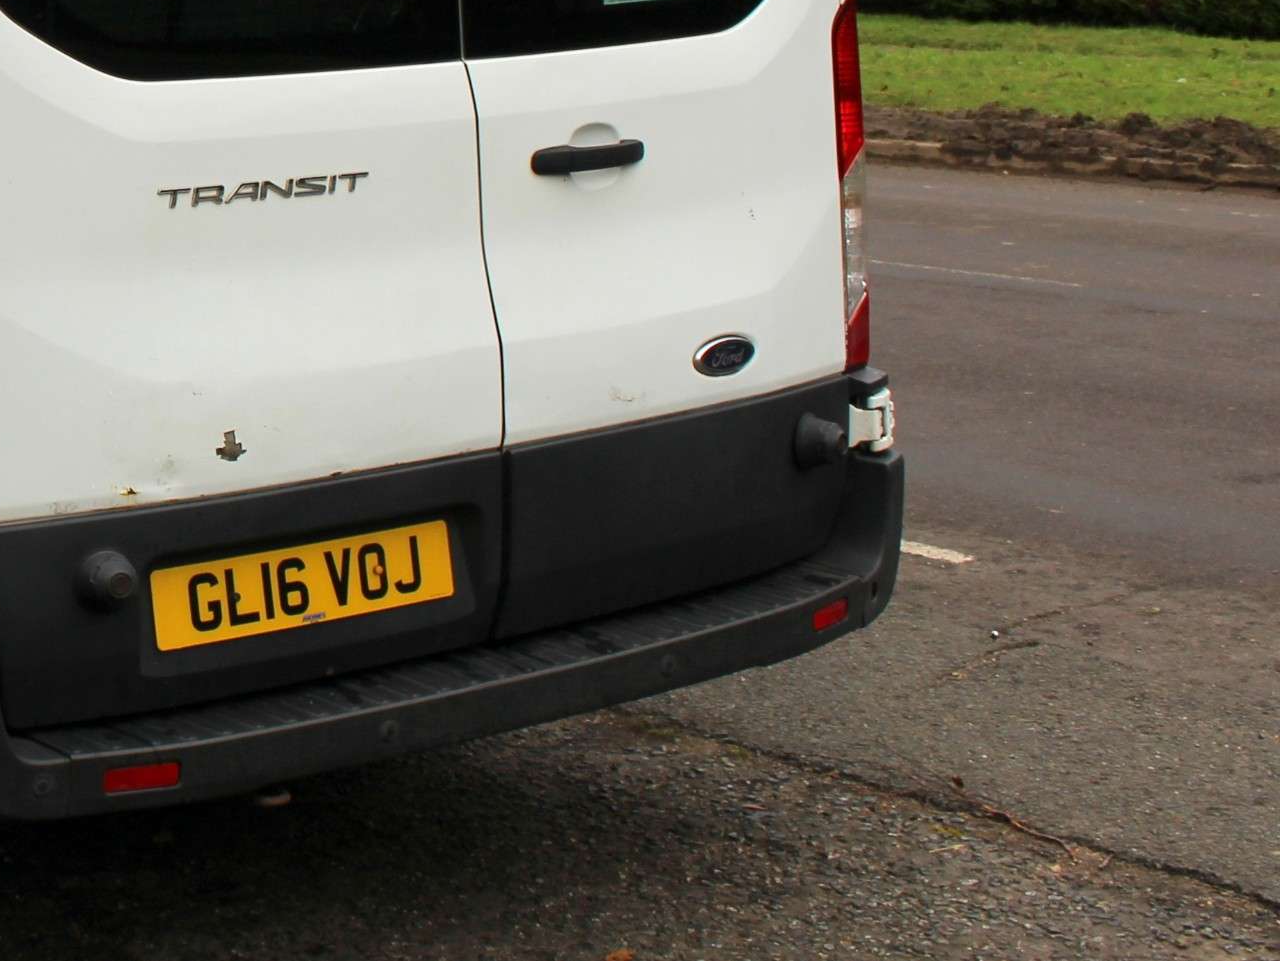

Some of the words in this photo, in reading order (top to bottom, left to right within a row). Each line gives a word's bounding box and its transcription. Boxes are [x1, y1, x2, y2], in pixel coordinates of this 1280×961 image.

[157, 171, 370, 210] TRANSIT
[187, 557, 310, 632] GL16
[323, 535, 422, 607] VOJ
